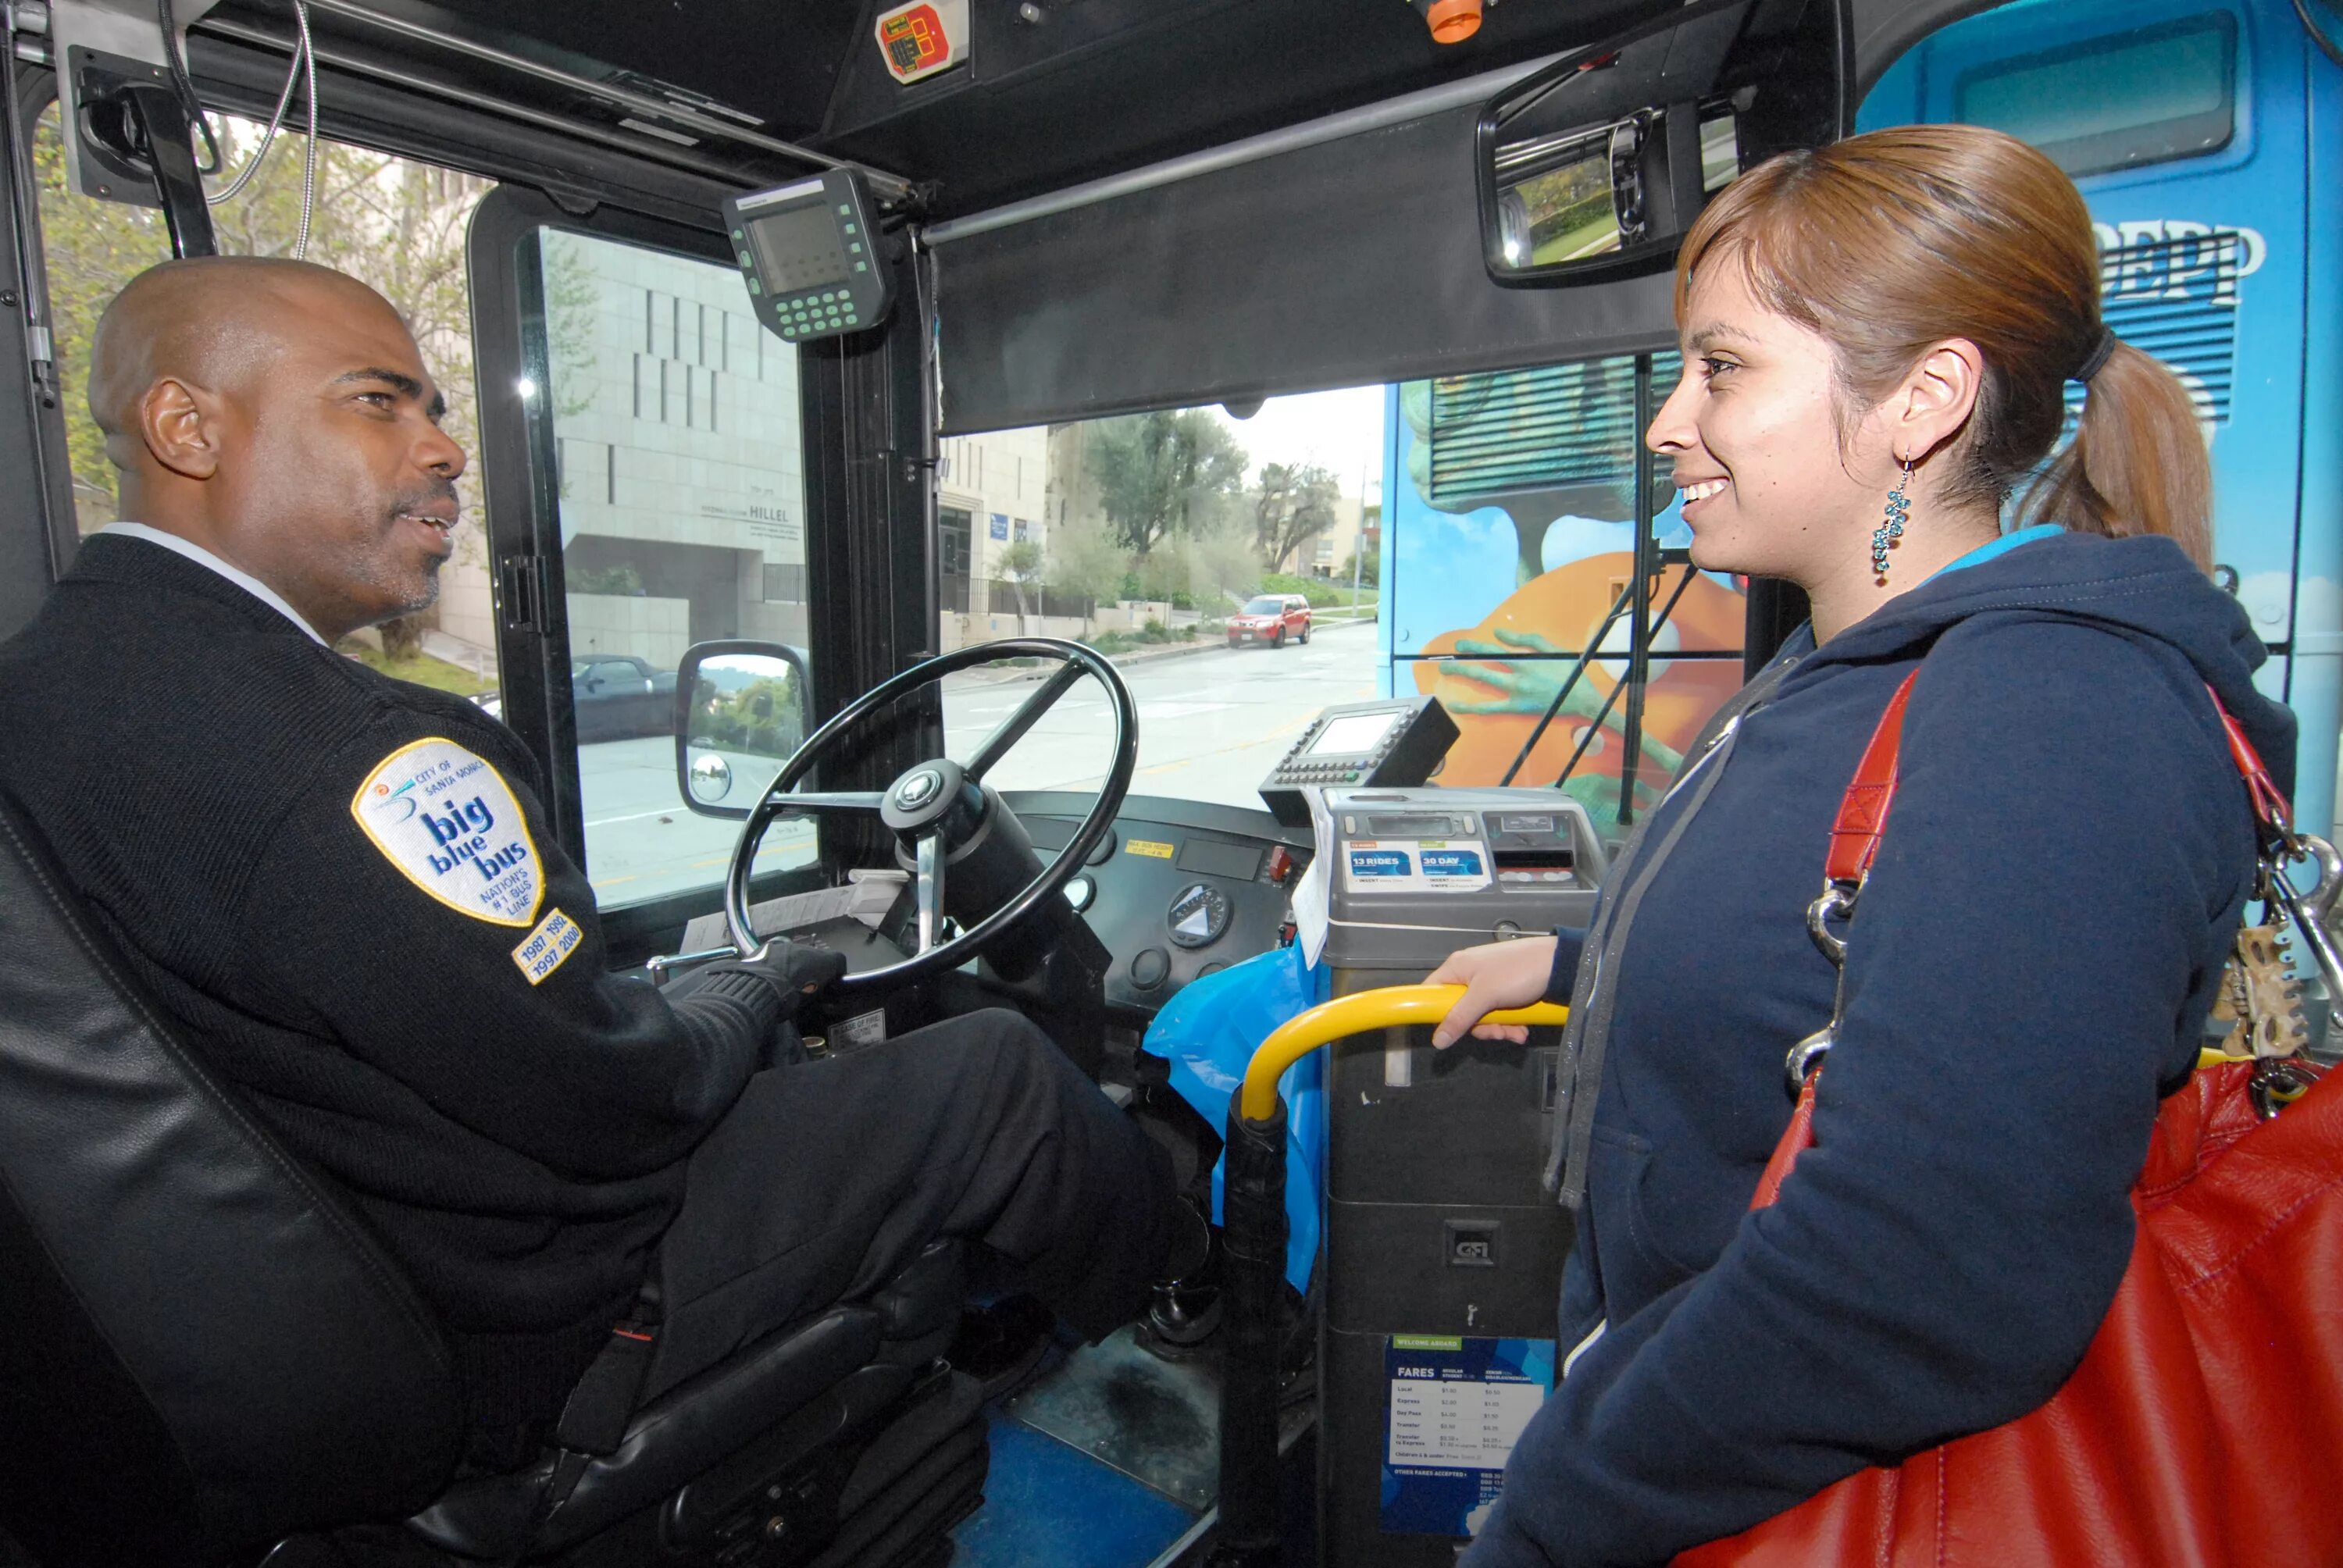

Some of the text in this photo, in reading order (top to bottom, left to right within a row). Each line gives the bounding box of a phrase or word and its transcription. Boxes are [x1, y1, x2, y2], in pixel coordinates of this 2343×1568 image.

[749, 505, 789, 522] HILLEL
[415, 760, 451, 784] CITY OF
[425, 775, 457, 796] SANTA
[420, 796, 494, 846] big
[426, 836, 487, 876] blue
[473, 841, 526, 881] bus
[480, 868, 528, 903] NATION'S
[510, 880, 532, 898] BUS
[507, 894, 530, 915] LINE
[522, 915, 568, 961] 1987 1992
[533, 926, 580, 976] 1997 2000
[1397, 1367, 1435, 1377] FARES
